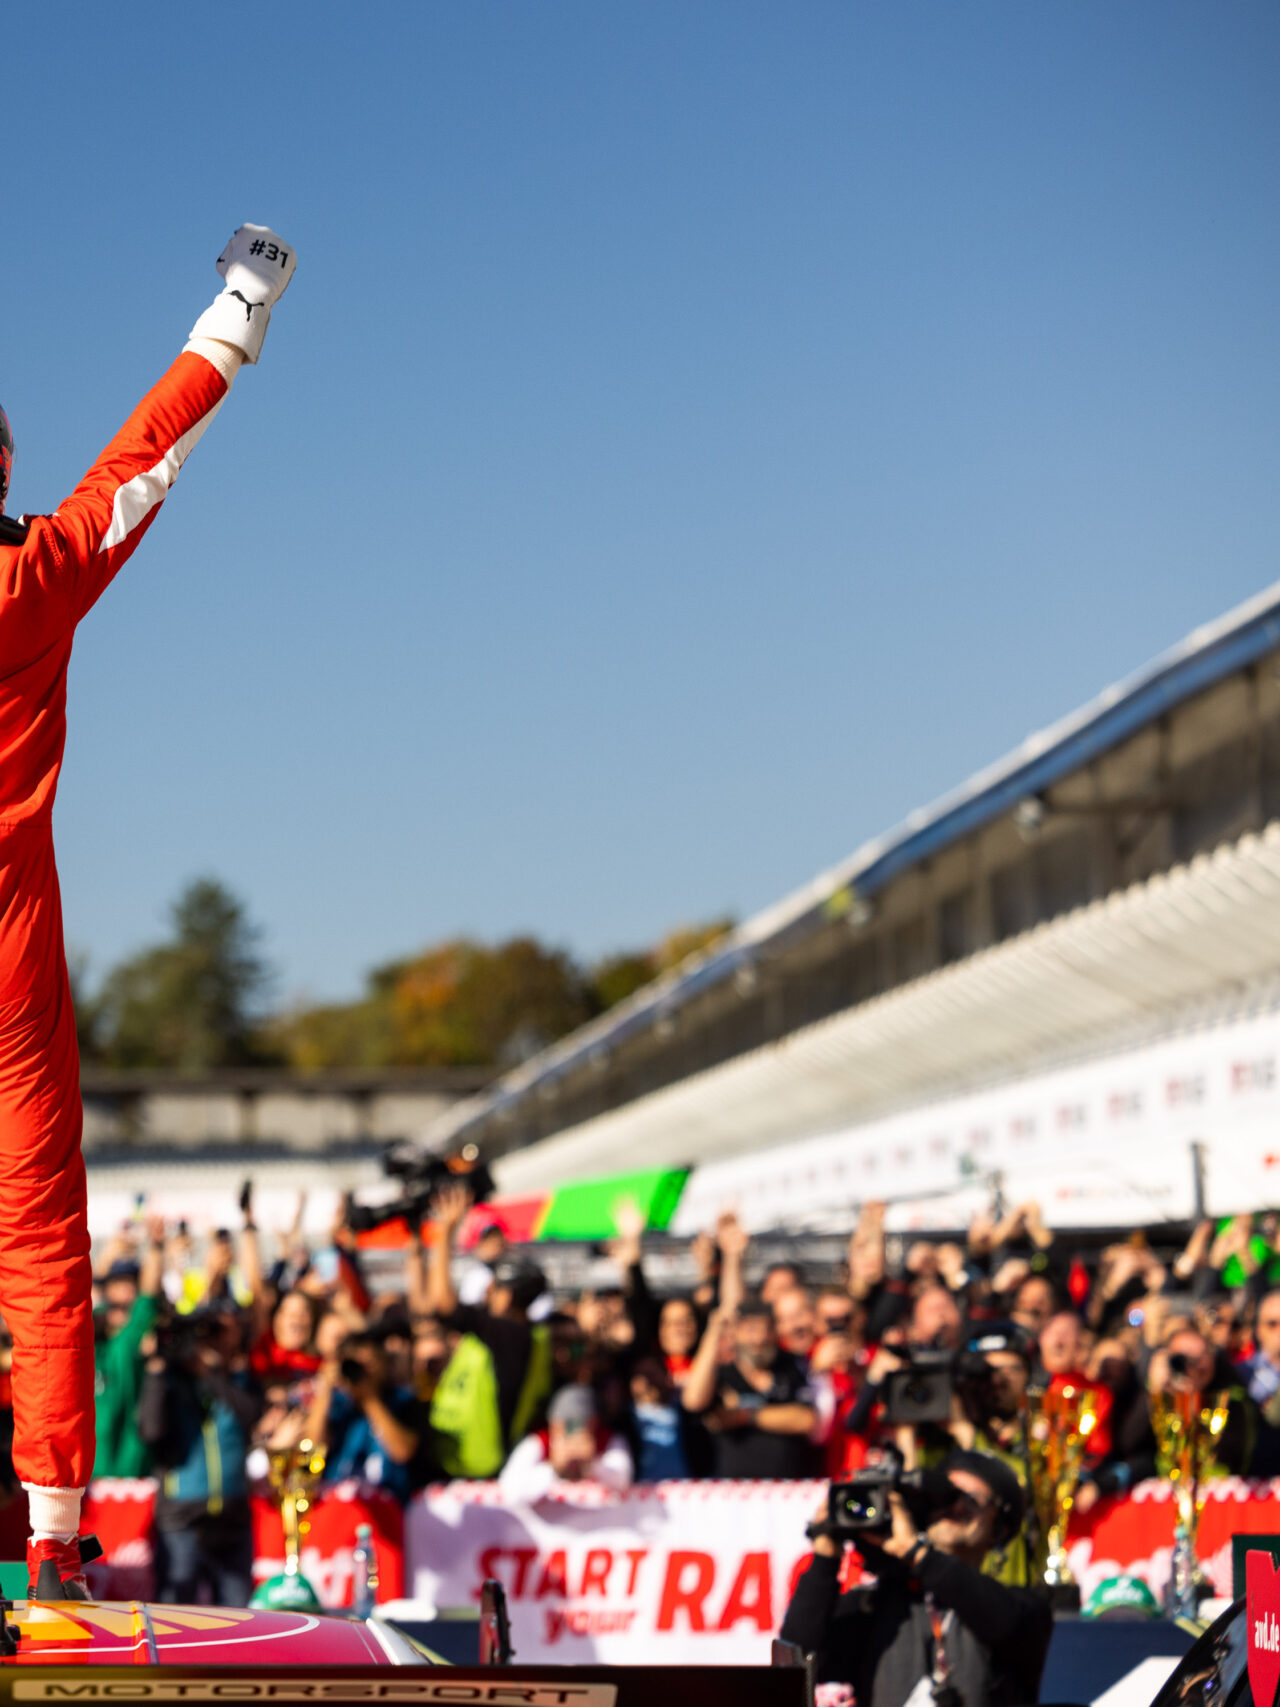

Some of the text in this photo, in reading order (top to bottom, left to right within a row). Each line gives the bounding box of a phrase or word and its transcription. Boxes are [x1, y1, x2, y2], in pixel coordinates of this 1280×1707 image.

[248, 239, 289, 269] #31
[473, 1546, 650, 1602] START
[1254, 1611, 1280, 1653] avd.de
[44, 1682, 590, 1704] MOTORSPORT
